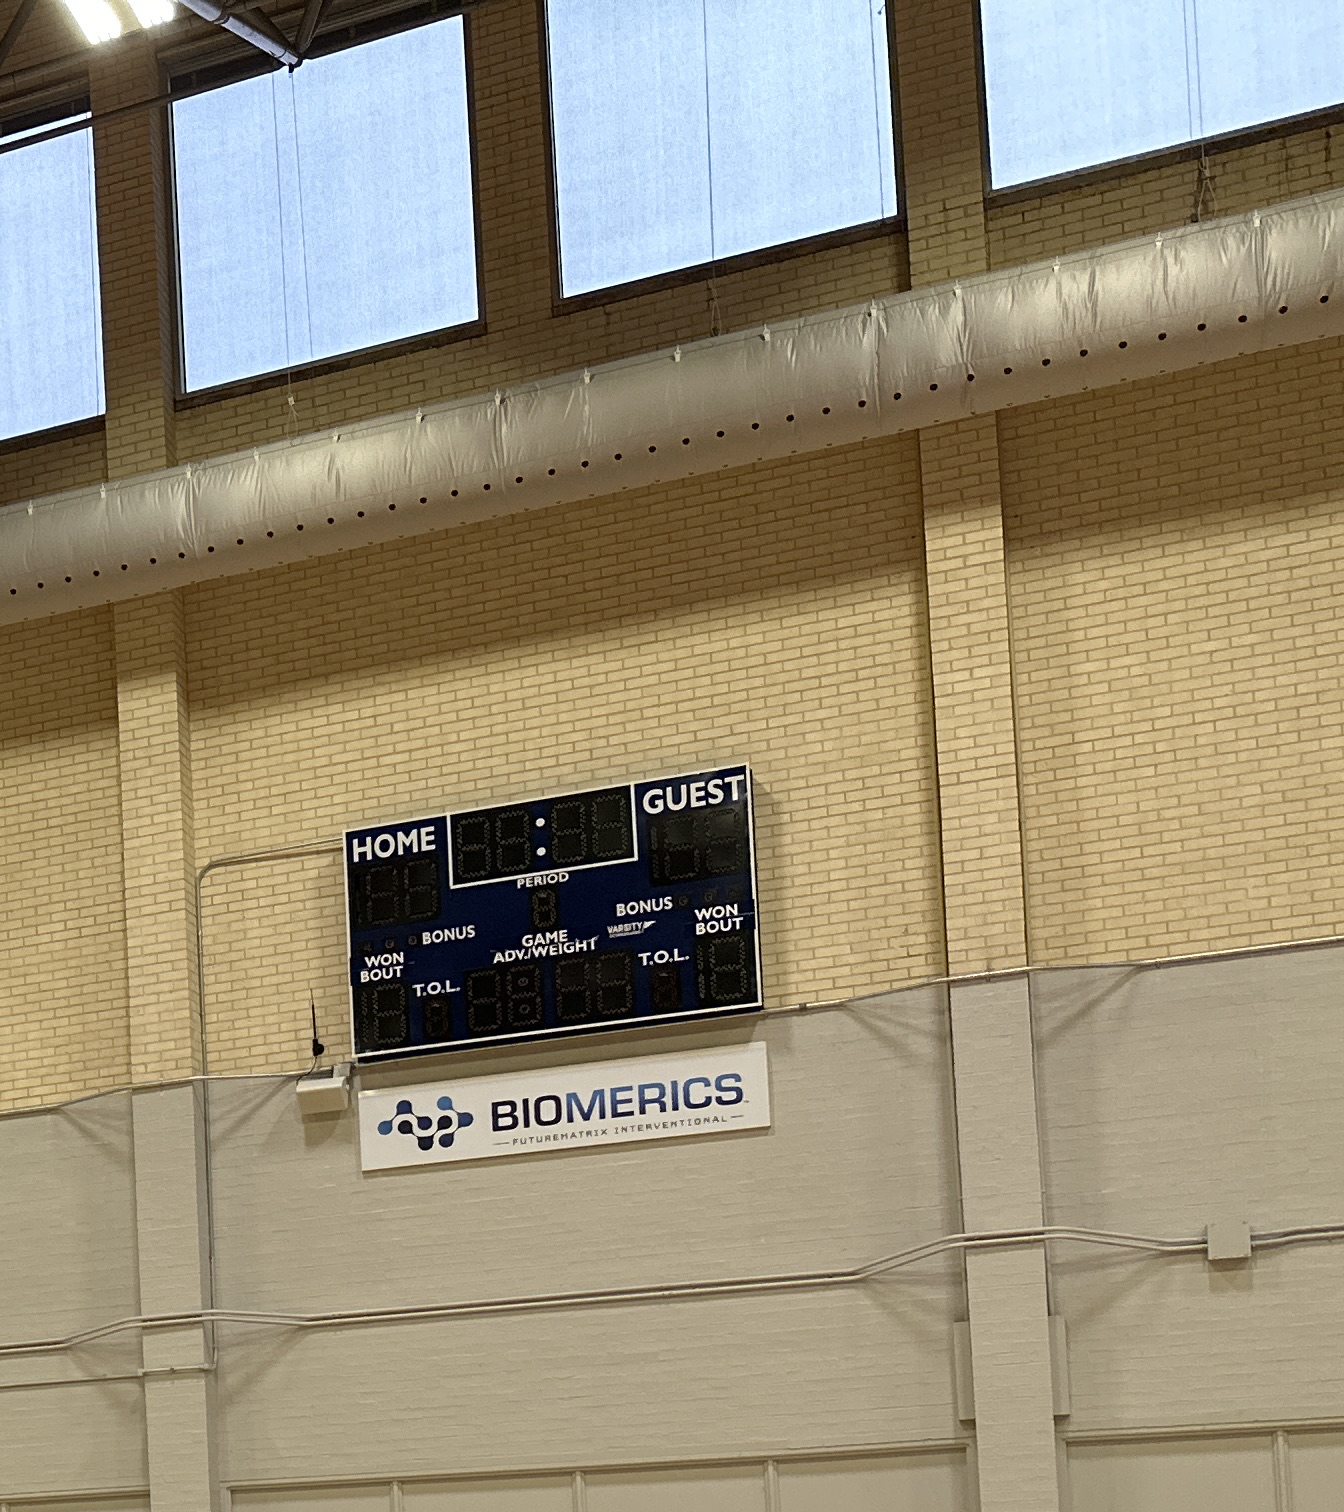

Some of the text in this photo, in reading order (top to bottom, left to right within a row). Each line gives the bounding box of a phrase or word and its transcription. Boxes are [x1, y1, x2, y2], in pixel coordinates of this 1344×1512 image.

[643, 774, 745, 815] GUEST
[352, 826, 437, 863] HOME
[516, 871, 570, 890] PERIOD
[616, 896, 674, 918] BONUS
[694, 903, 739, 921] WON
[422, 924, 476, 946] BONUS
[695, 917, 744, 936] BOUT
[521, 929, 569, 947] GAME
[364, 951, 405, 969] WON
[637, 948, 690, 967] T.O.L.
[360, 966, 404, 983] BOUT
[412, 980, 461, 998] T.O.L.
[491, 1073, 744, 1132] BIOMERICS
[614, 1116, 728, 1135] INTERVENTIONAL
